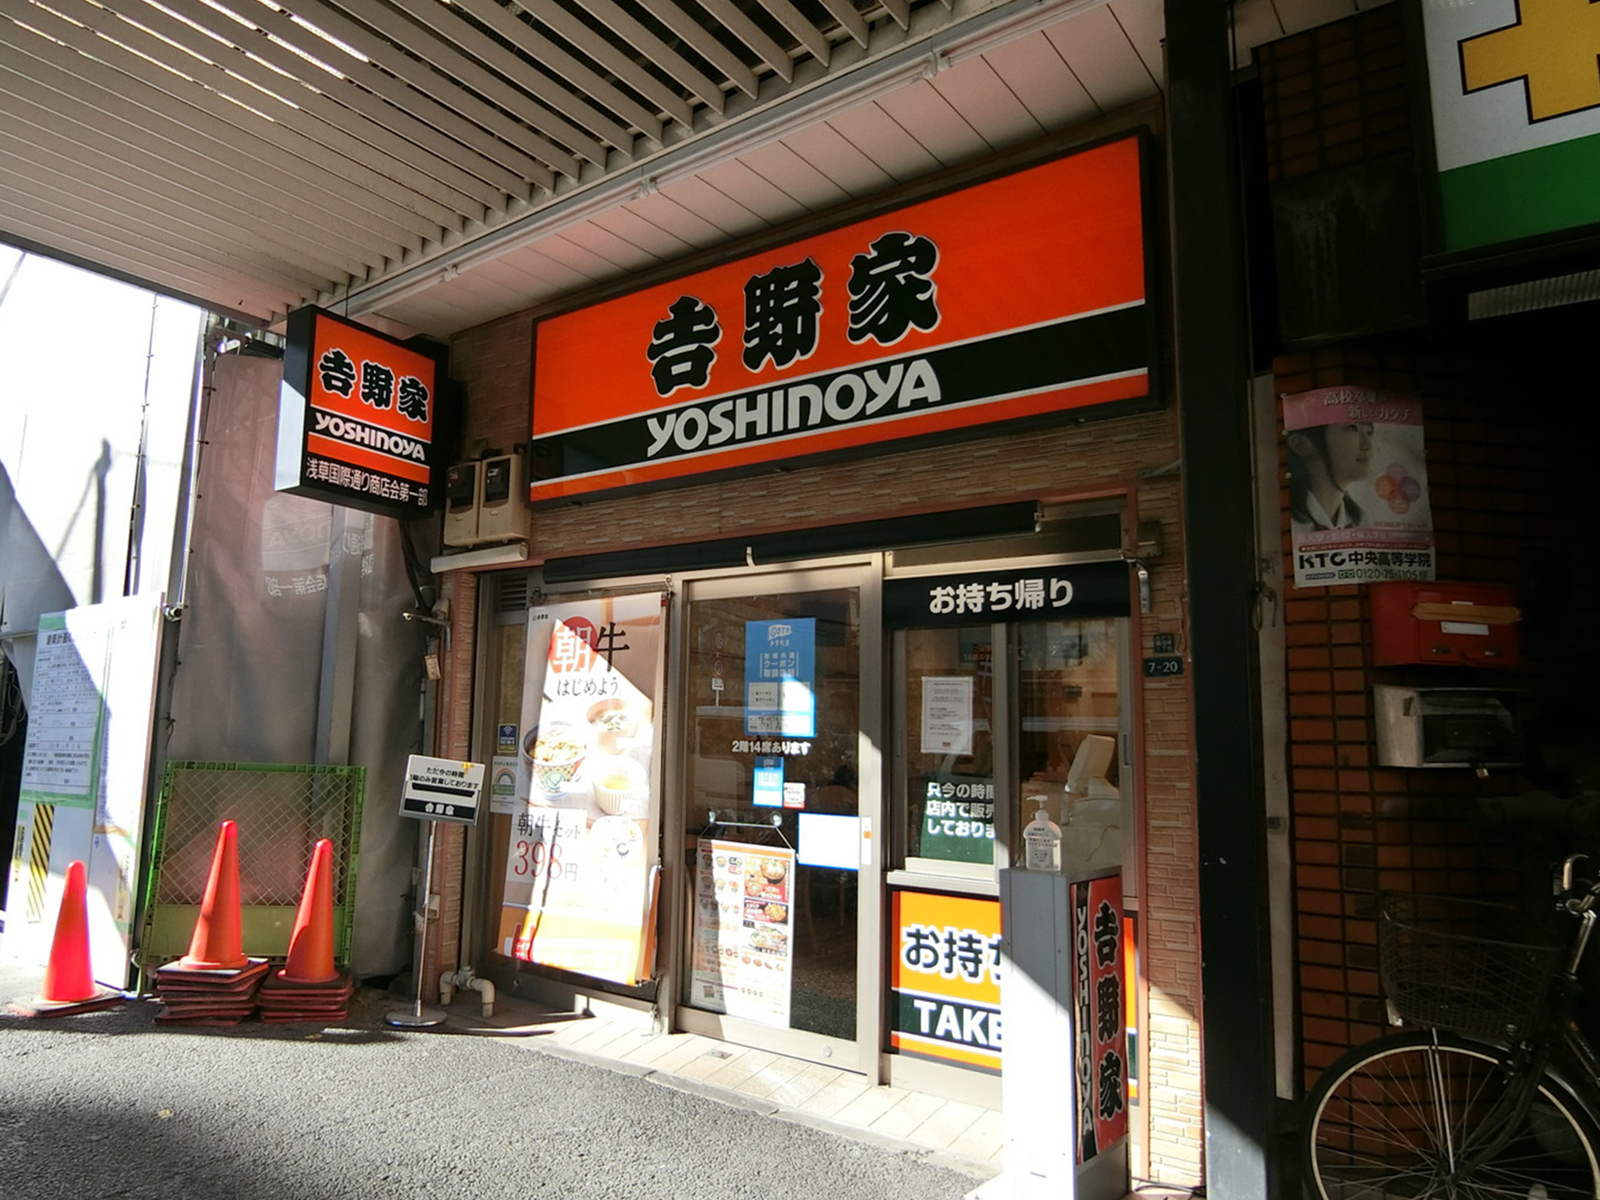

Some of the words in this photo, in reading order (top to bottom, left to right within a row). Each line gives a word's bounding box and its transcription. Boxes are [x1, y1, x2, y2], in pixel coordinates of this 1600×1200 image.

[647, 231, 941, 398] 吉野家
[317, 347, 430, 424] 吉野家
[646, 359, 942, 458] YOSHINOYA
[314, 411, 427, 461] YOSHINOYA
[1299, 551, 1346, 569] KTC
[1349, 551, 1432, 567] 中央高等学院
[929, 577, 1074, 614] お持ち帰り
[1148, 661, 1178, 674] 7-20
[732, 741, 811, 755] 2階14席あります
[1094, 900, 1124, 1122] 吉野家
